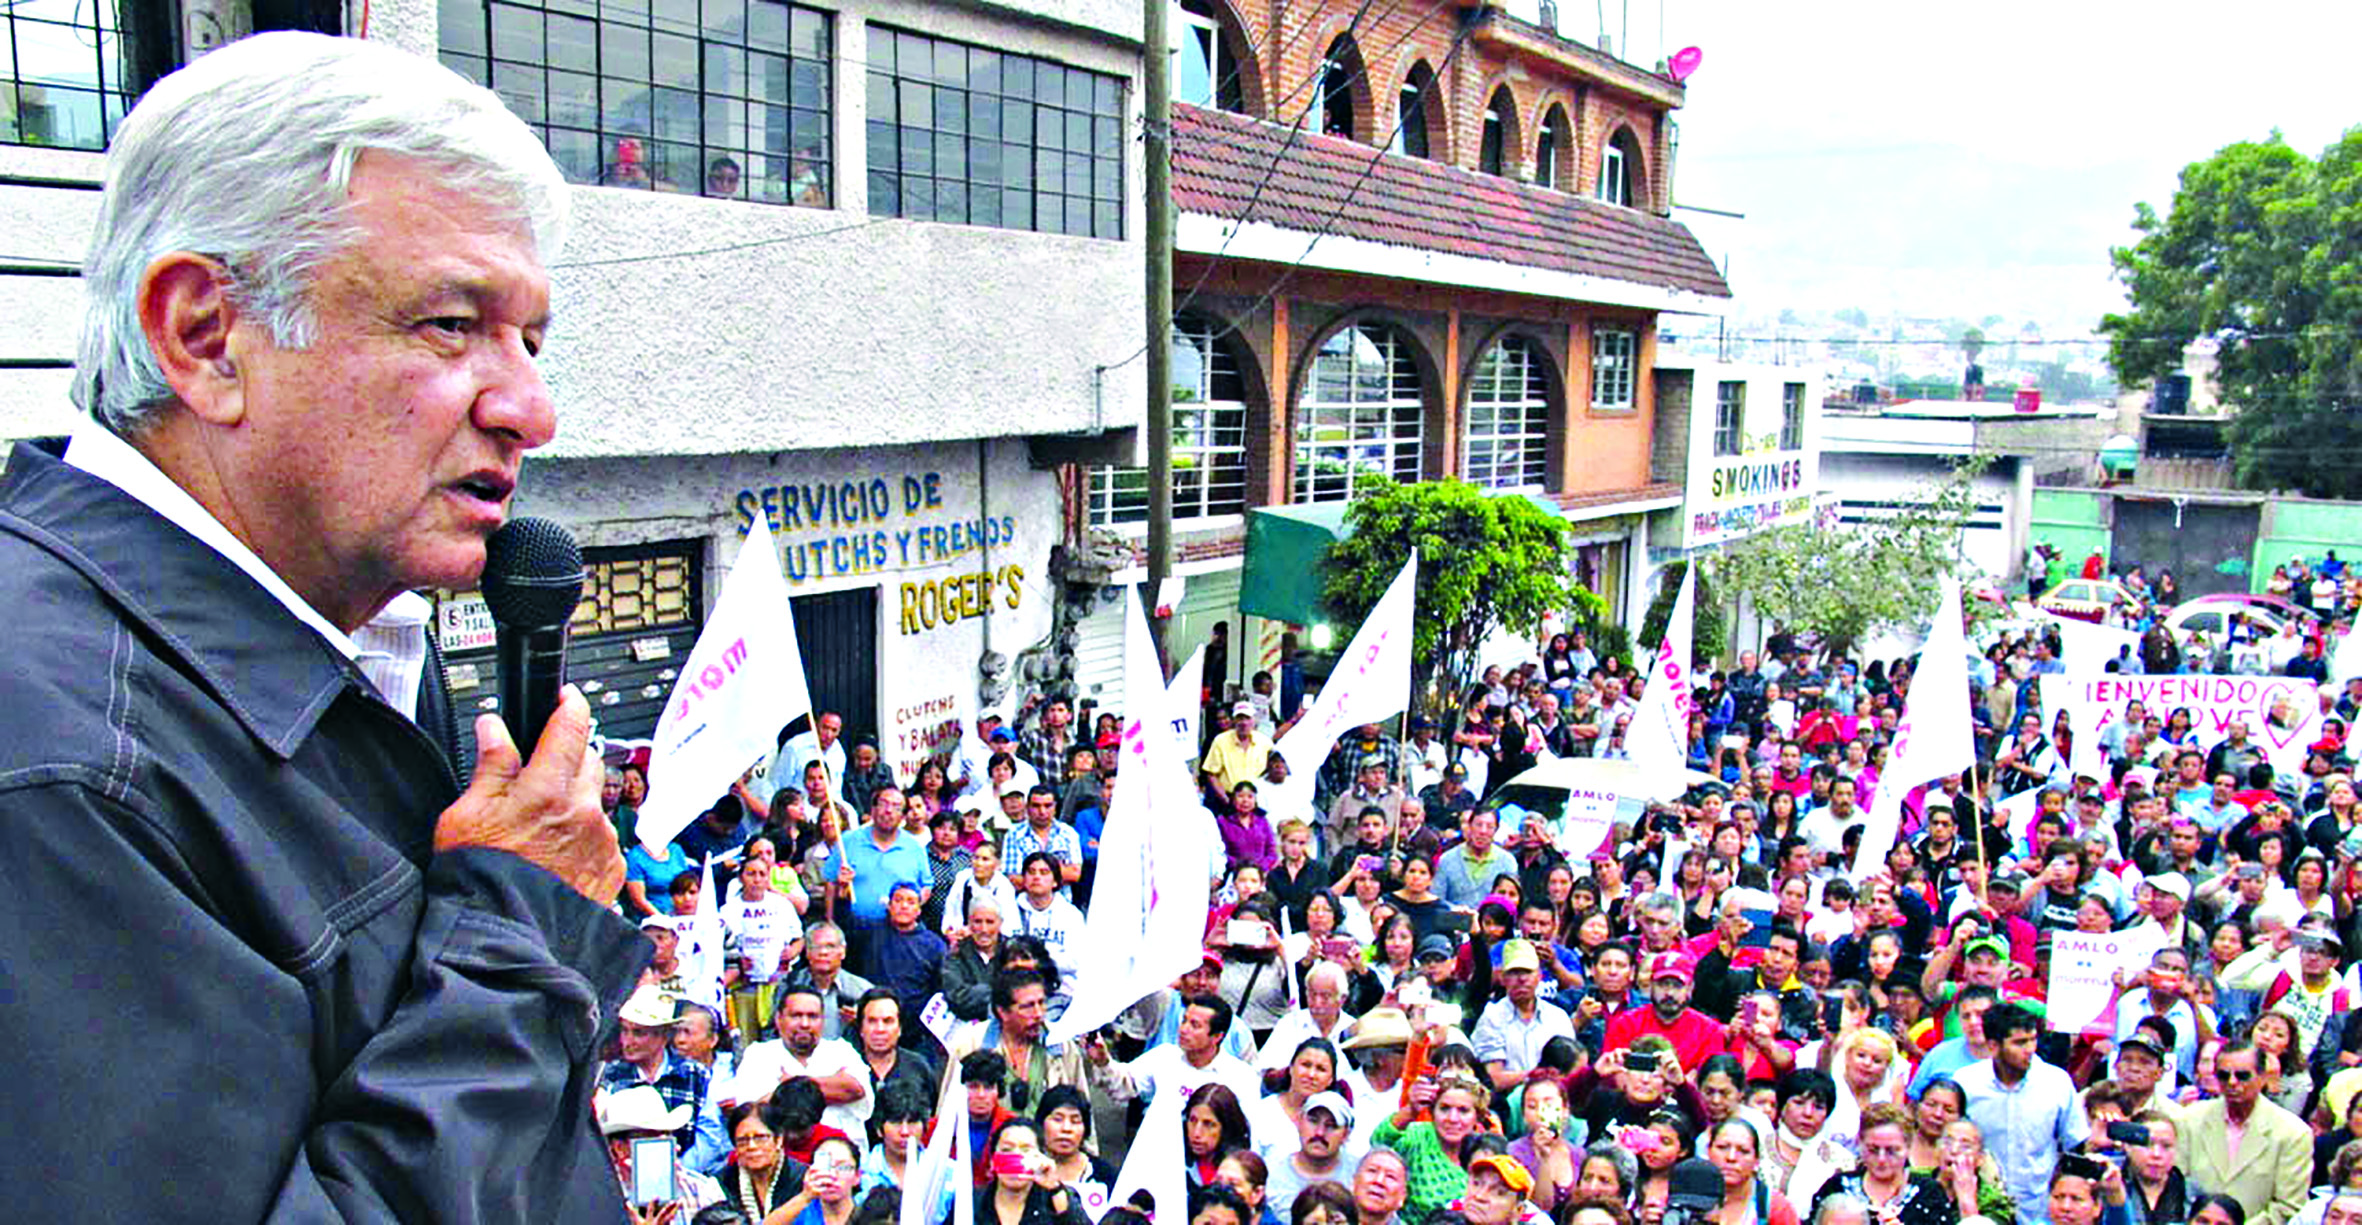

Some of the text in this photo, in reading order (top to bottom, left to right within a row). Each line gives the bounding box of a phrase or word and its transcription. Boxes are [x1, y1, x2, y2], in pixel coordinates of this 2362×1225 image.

[1712, 458, 1801, 499] SMOKINGS
[735, 471, 942, 539] SERVICIO DE
[783, 514, 1018, 585] UTCHS Y FRENOS
[900, 563, 1025, 636] ROGER'S
[2086, 678, 2258, 703] IENVENIDO
[1572, 789, 1616, 802] AMLO
[2057, 939, 2119, 955] AMLO
